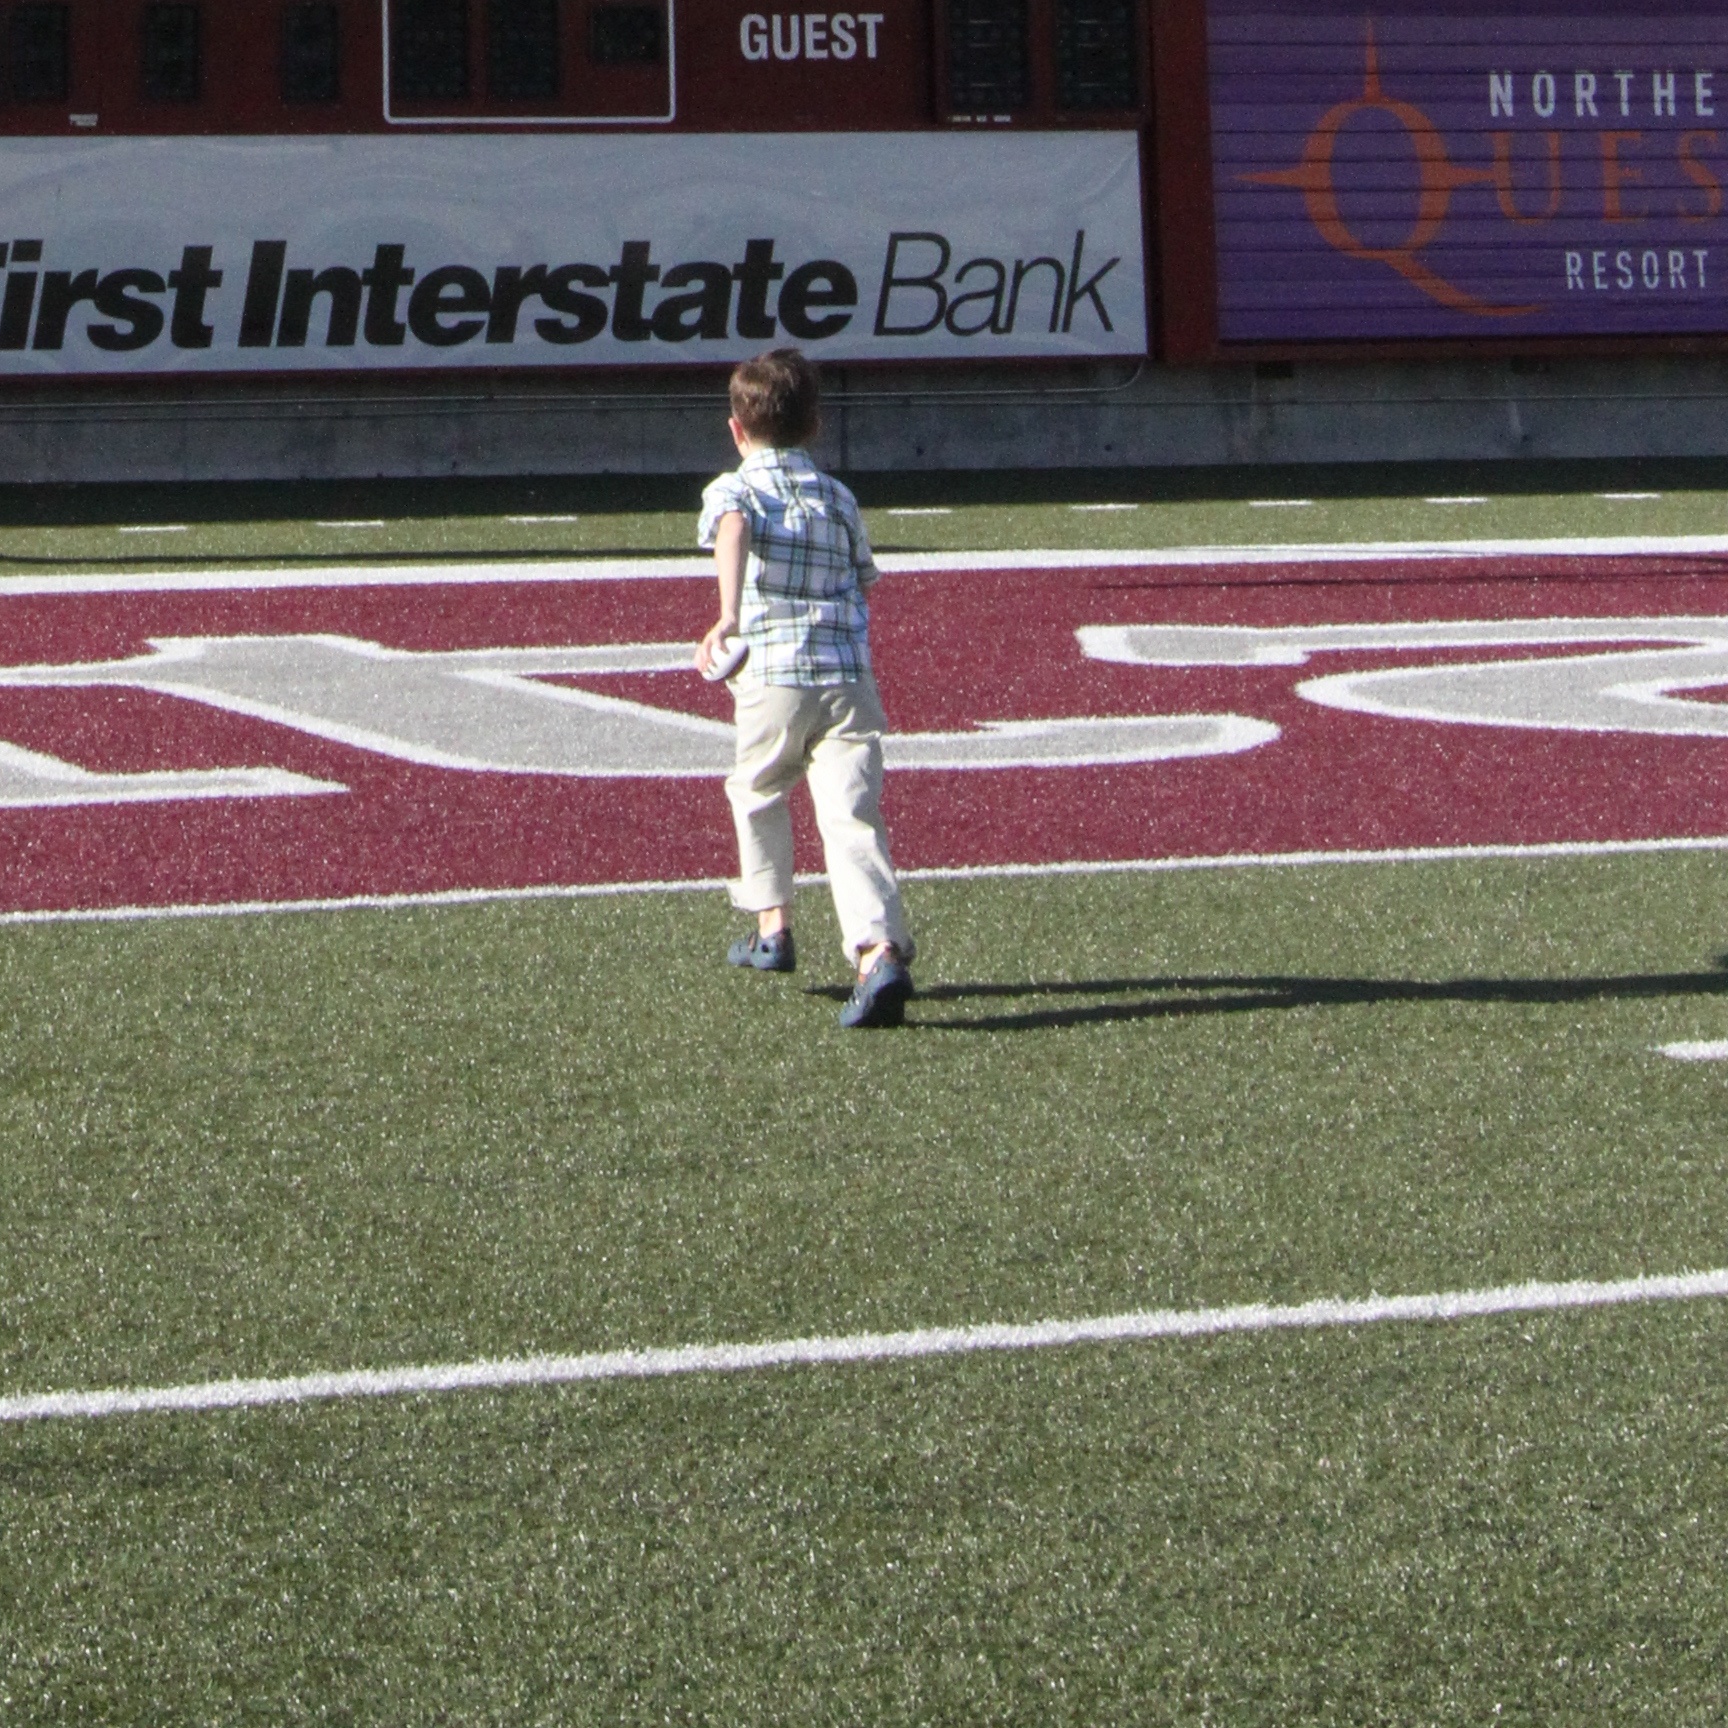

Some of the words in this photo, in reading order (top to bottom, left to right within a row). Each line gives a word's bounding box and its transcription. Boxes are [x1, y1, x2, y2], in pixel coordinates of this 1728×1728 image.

[739, 12, 884, 61] GUEST
[1489, 71, 1715, 118] NORTHE
[238, 238, 858, 350] Interstate
[875, 229, 1120, 338] Bank
[1565, 249, 1708, 290] RESORT
